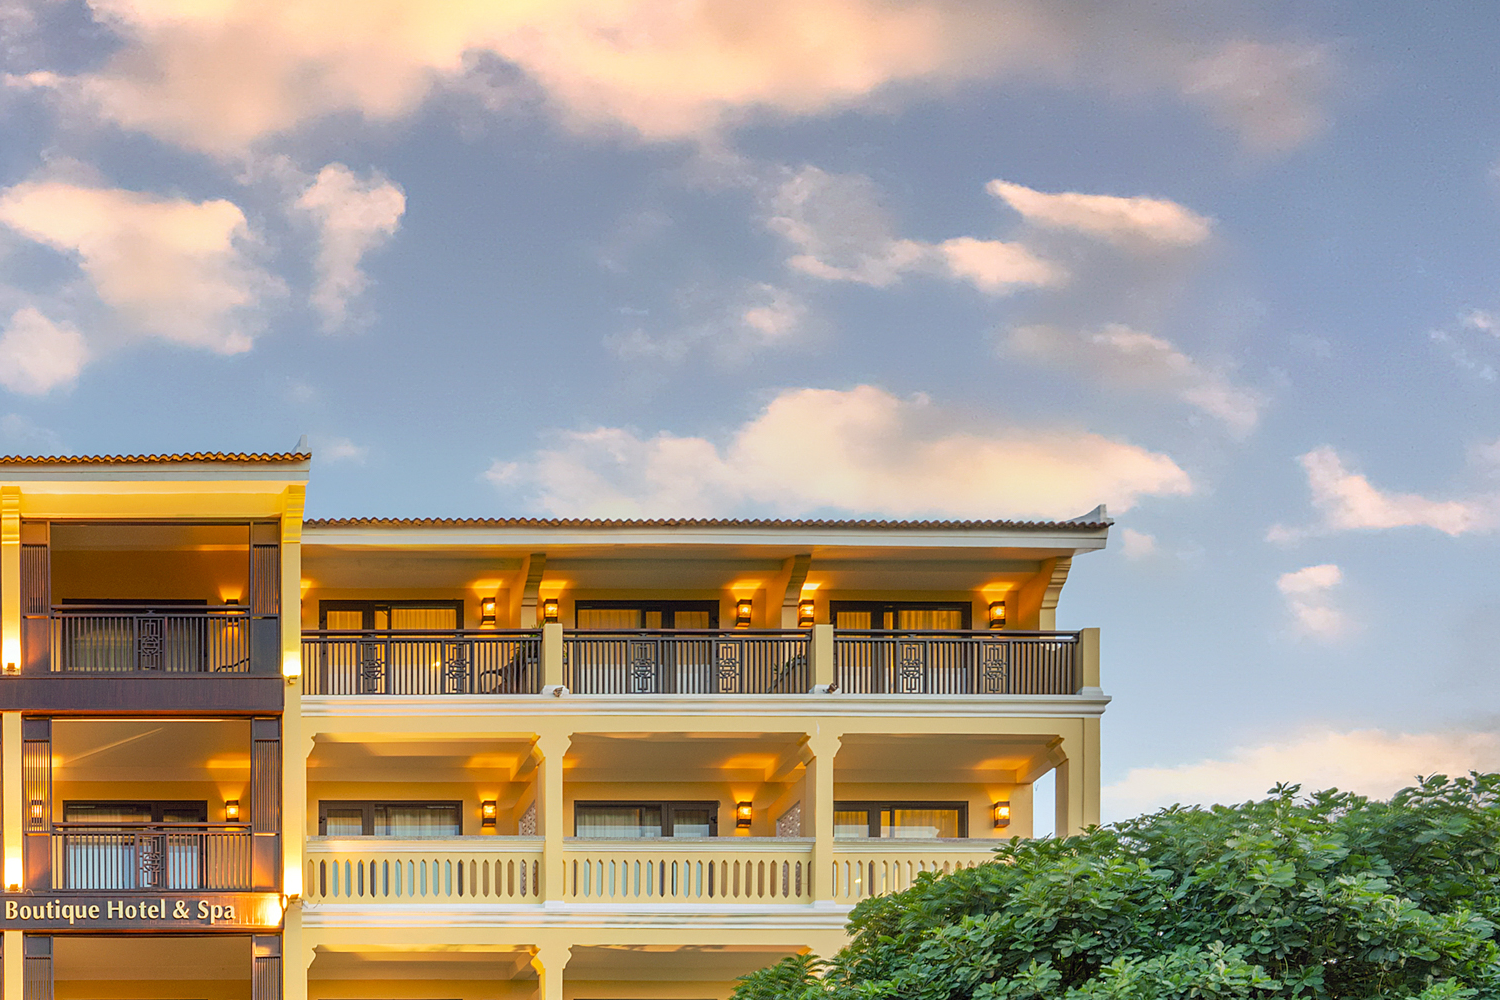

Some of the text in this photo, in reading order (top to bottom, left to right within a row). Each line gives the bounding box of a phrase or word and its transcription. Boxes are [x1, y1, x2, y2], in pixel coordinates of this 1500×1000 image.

[5, 899, 100, 925] Boutique
[107, 898, 166, 920] Hotel
[172, 900, 190, 920] &
[197, 900, 237, 925] Spa
